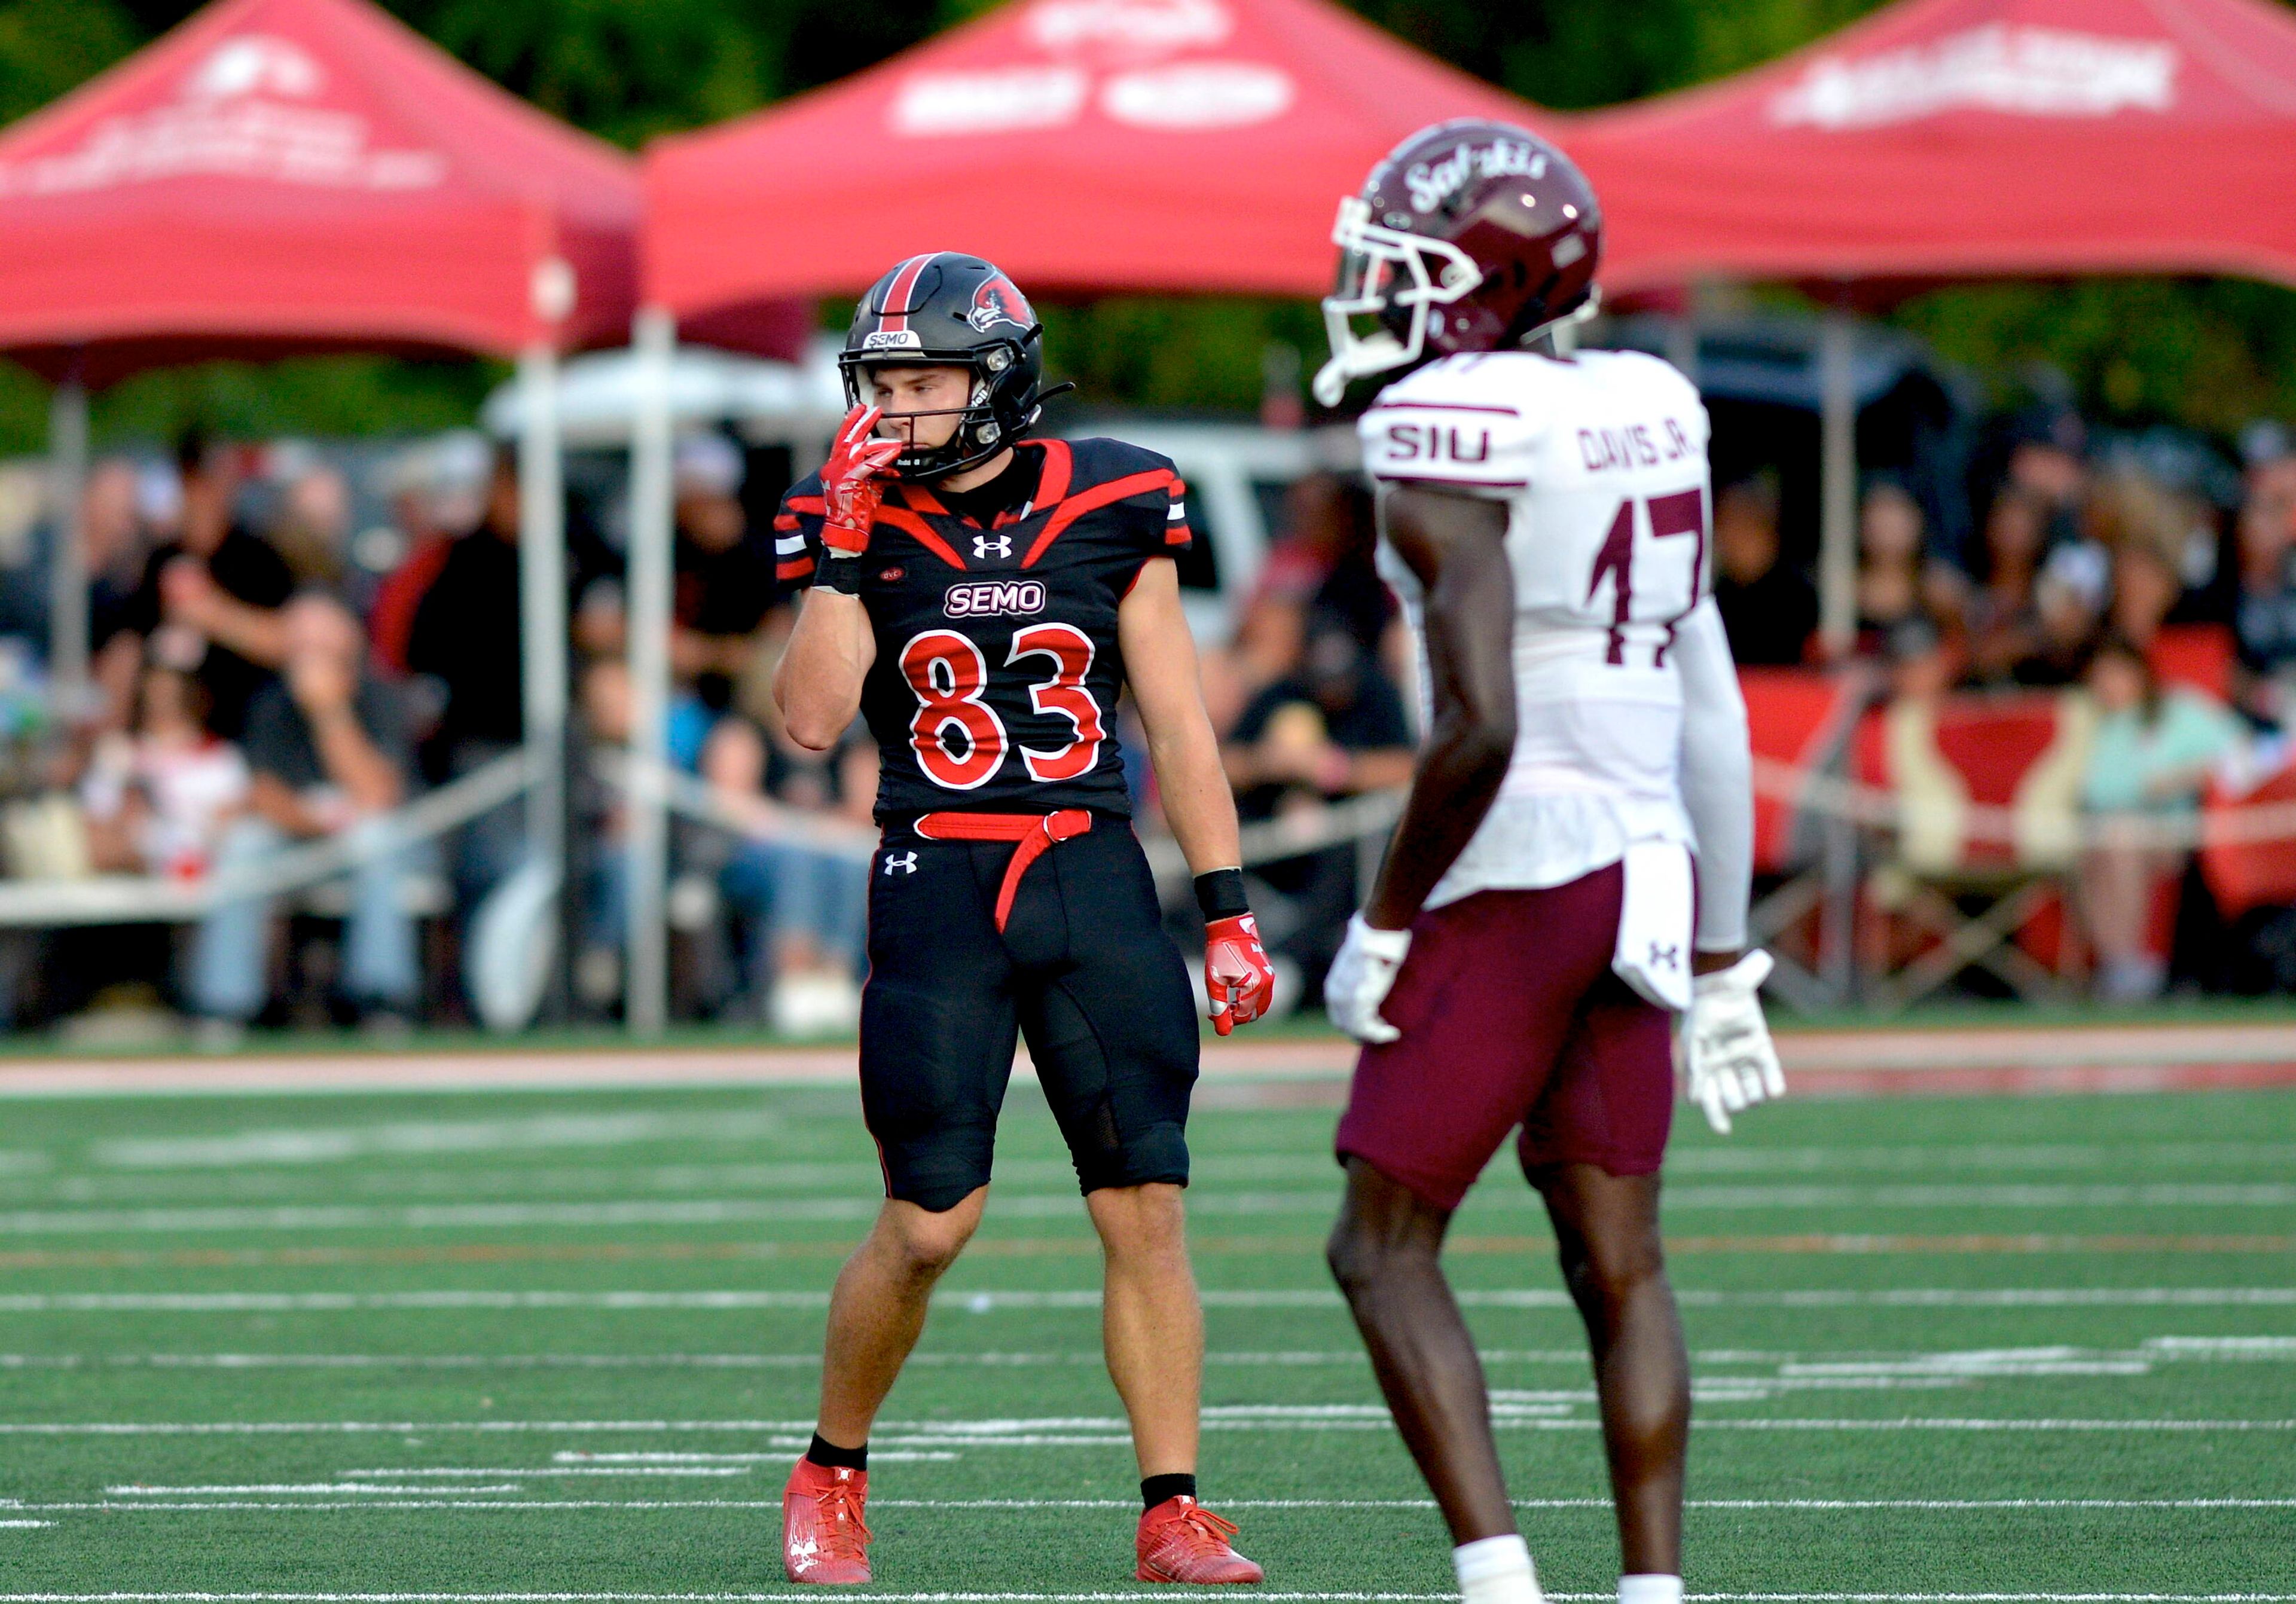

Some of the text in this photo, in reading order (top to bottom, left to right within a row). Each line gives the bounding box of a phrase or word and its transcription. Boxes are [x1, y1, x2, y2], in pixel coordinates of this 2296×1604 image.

[869, 334, 908, 346] SEMO
[1389, 424, 1489, 462] SIU
[1577, 425, 1659, 471] DAVIS
[1586, 488, 1703, 668] 17
[945, 582, 1045, 617] SEMO
[899, 622, 1106, 790] 83
